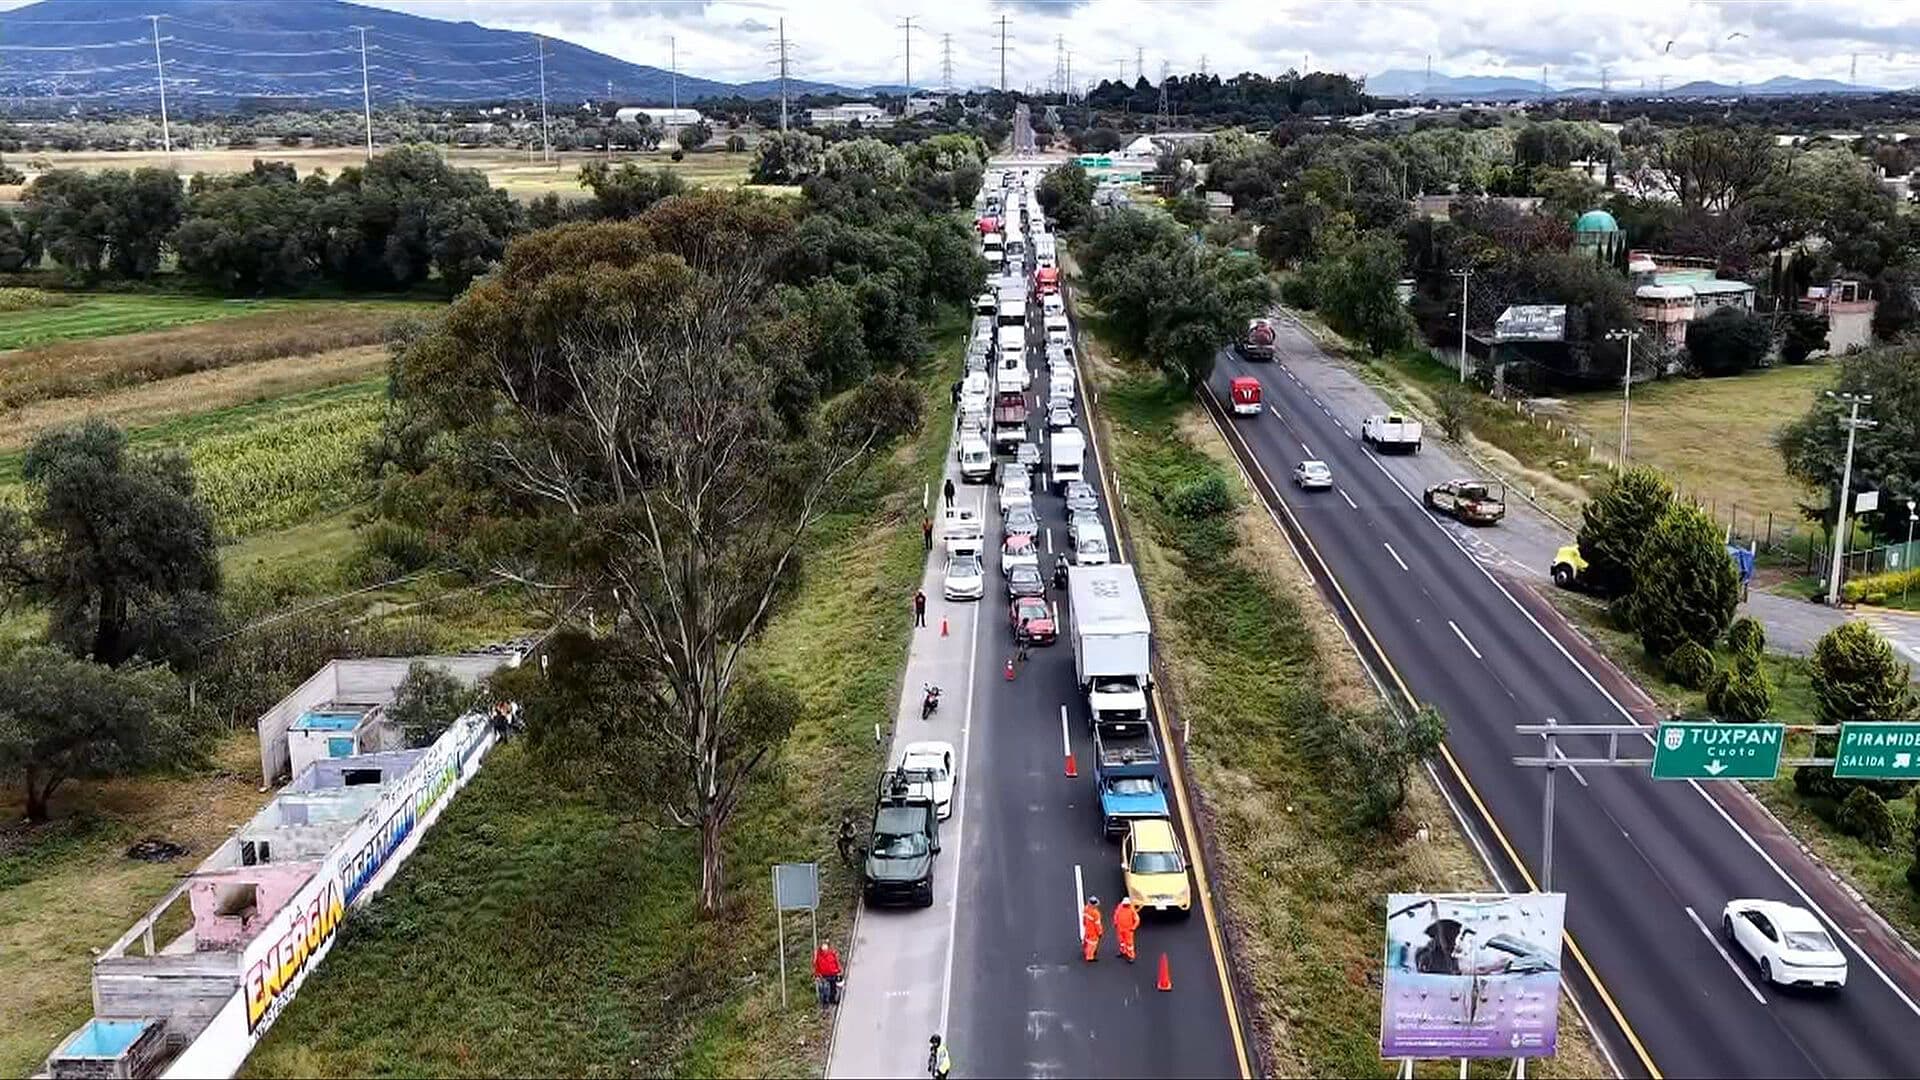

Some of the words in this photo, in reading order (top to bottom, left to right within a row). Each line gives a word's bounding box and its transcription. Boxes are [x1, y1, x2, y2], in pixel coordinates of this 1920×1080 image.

[1690, 728, 1777, 745] TUXPAN
[1706, 746, 1756, 757] Cuota
[1841, 754, 1885, 768] SALIDA
